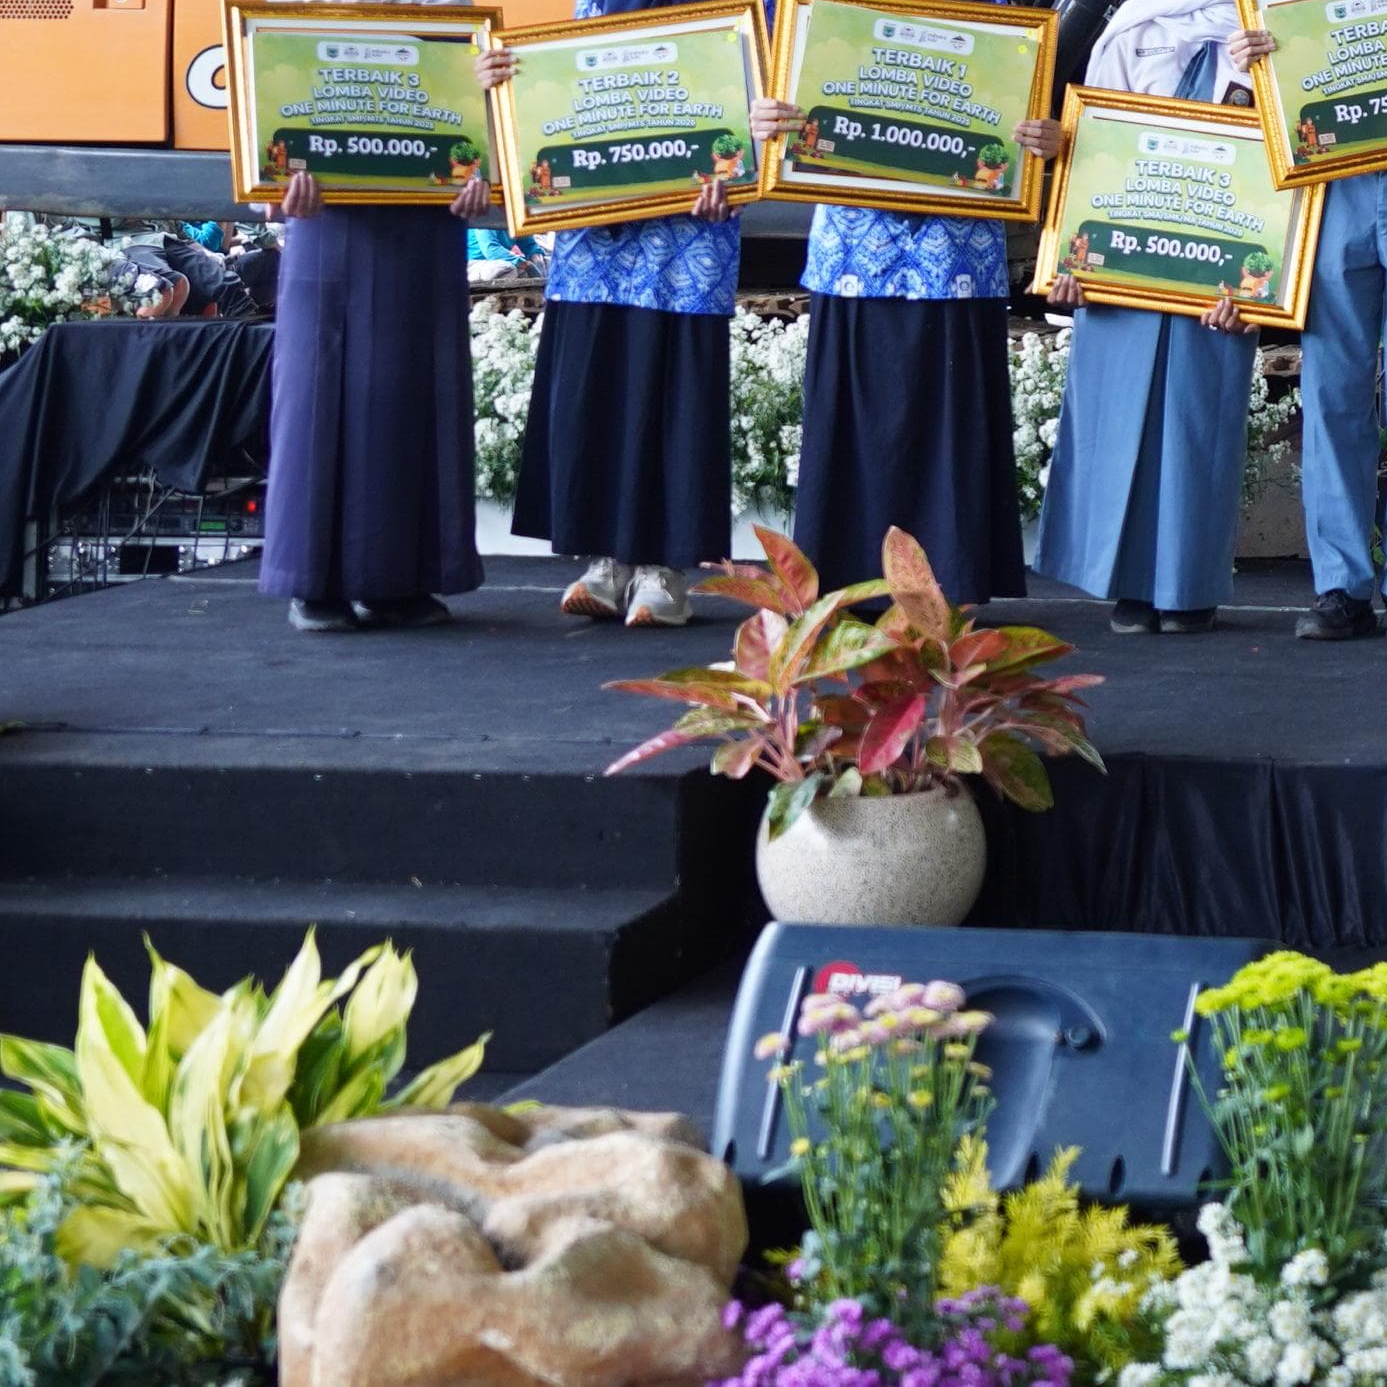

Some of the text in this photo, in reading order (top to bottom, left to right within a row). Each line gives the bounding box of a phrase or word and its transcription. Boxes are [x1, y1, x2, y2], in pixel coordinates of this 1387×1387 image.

[873, 47, 967, 79] TERBAIK 1
[1328, 41, 1385, 64] LOMBA
[320, 69, 420, 86] TERBAIK 3
[579, 71, 679, 95] TERBAIK 2
[859, 66, 972, 98] LOMBA VIDEO
[1302, 71, 1332, 91] ONE
[313, 85, 428, 104] LOMBA VIDEO
[573, 87, 689, 112] LOMBA VIDEO
[823, 81, 1001, 125] ONE MINUTE FOR EARTH
[281, 99, 462, 126] ONE MINUTE FOR EARTH
[543, 102, 723, 136] ONE MINUTE FOR EARTH
[1334, 105, 1367, 124] Rp.
[310, 135, 438, 159] Rp. 500.000,-
[833, 116, 976, 158] Rp. 1.000.000,-
[573, 140, 700, 170] Rp. 750.000,-
[1136, 160, 1231, 188] TERBAIK 3
[1126, 178, 1235, 206] LOMBA VIDEO
[1091, 194, 1265, 233] ONE MINUTE FOR EARTH
[1110, 231, 1233, 266] Rp. 500.000,-
